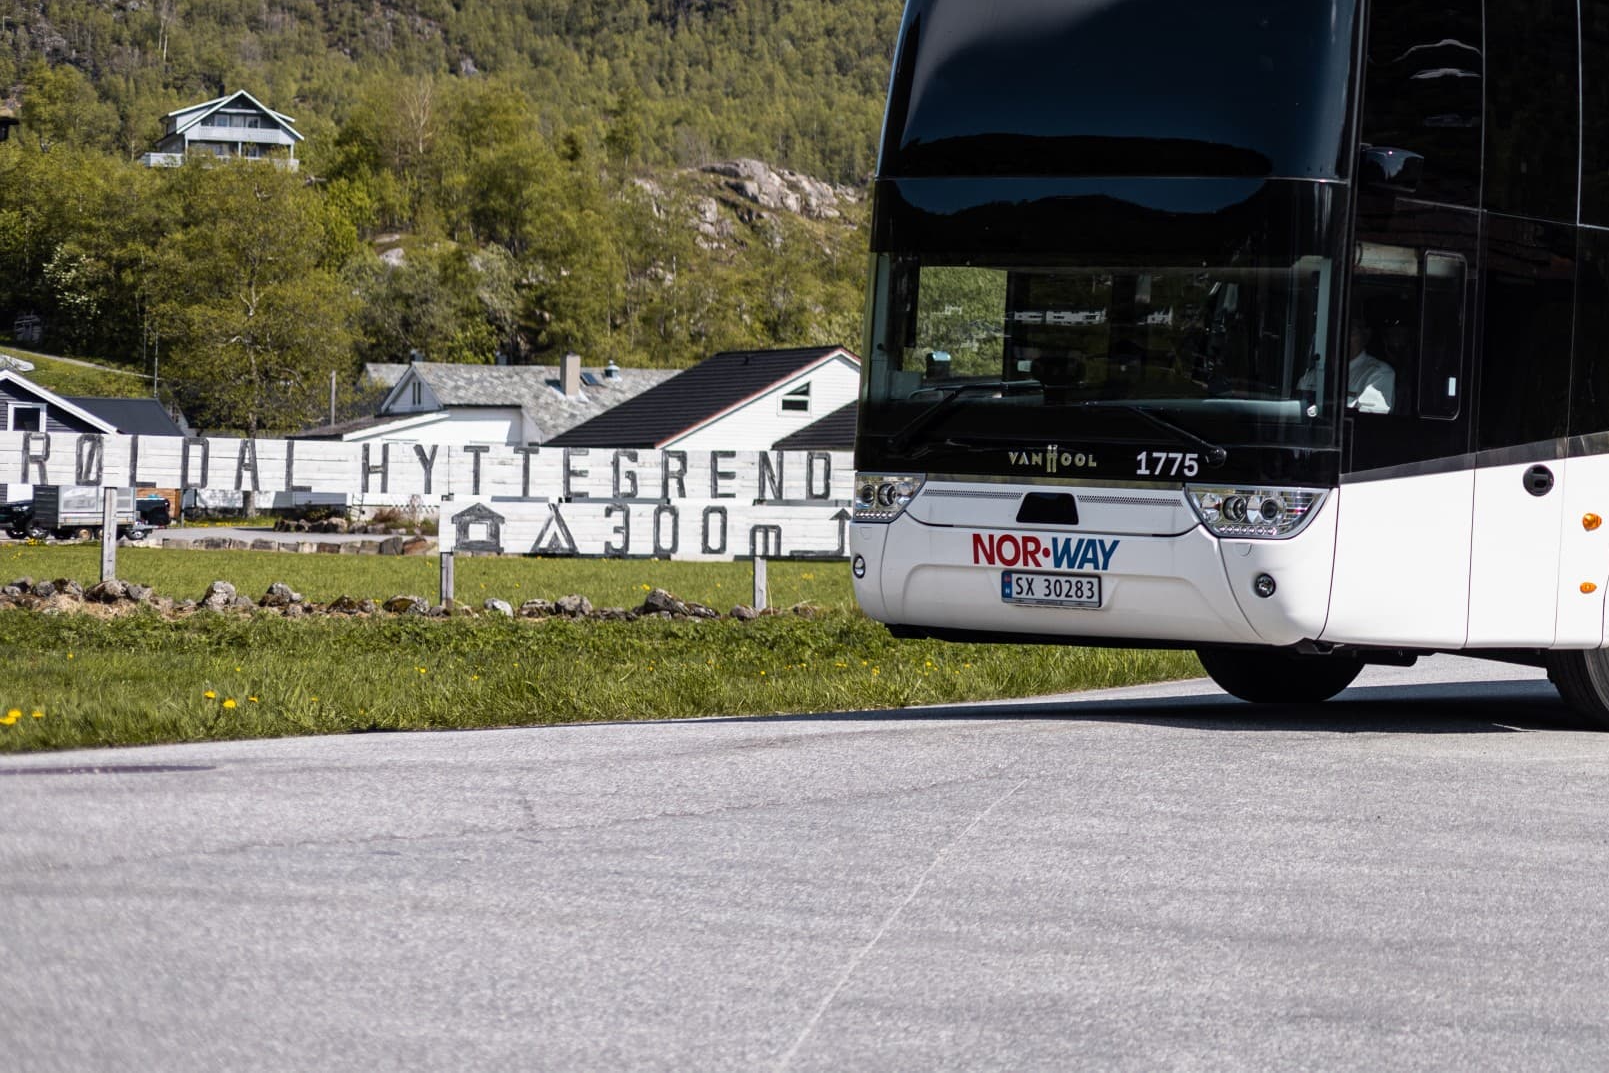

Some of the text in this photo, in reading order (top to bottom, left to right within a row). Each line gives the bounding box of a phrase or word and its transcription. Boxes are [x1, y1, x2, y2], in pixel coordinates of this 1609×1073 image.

[1136, 451, 1199, 476] 1775
[1015, 577, 1035, 597] SX
[1043, 578, 1095, 599] 30283
